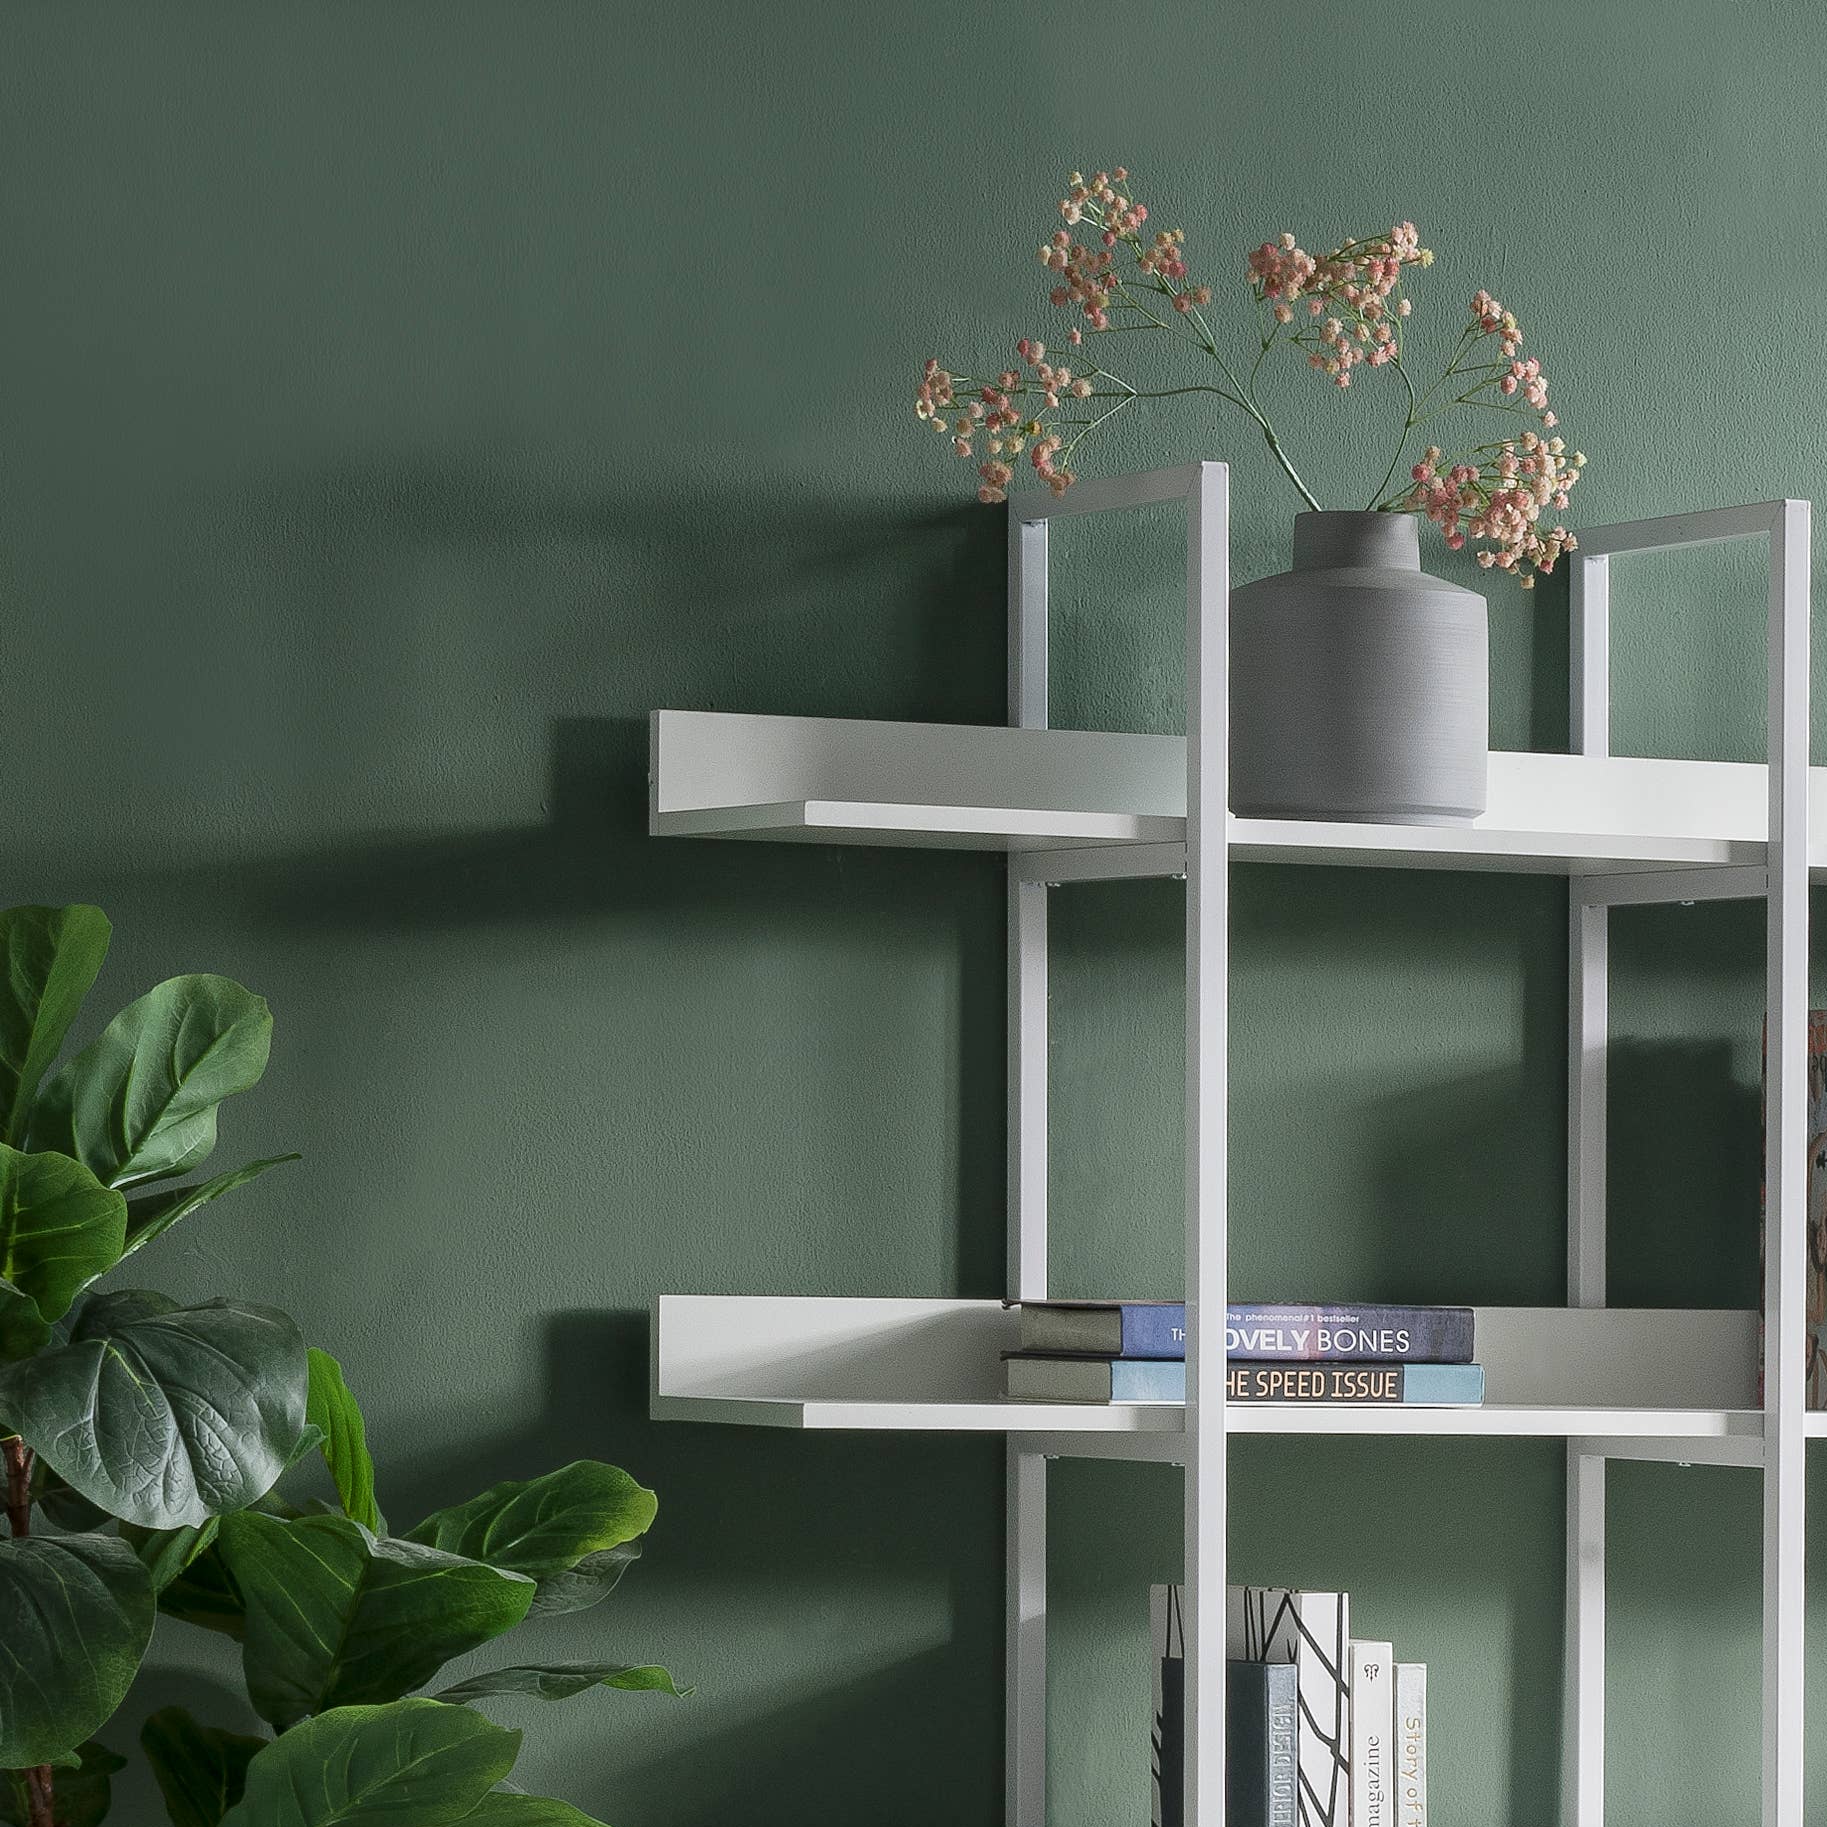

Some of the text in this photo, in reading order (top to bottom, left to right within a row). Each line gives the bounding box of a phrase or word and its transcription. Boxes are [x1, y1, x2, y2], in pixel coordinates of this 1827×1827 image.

[1245, 1313, 1303, 1323] phenomenal
[1318, 1313, 1360, 1323] bestseller
[1171, 1328, 1411, 1353] TH OVELY BONES
[1226, 1370, 1399, 1399] HE SPEED ISSUE
[1402, 1717, 1421, 1781] Story
[1406, 1787, 1423, 1812] of
